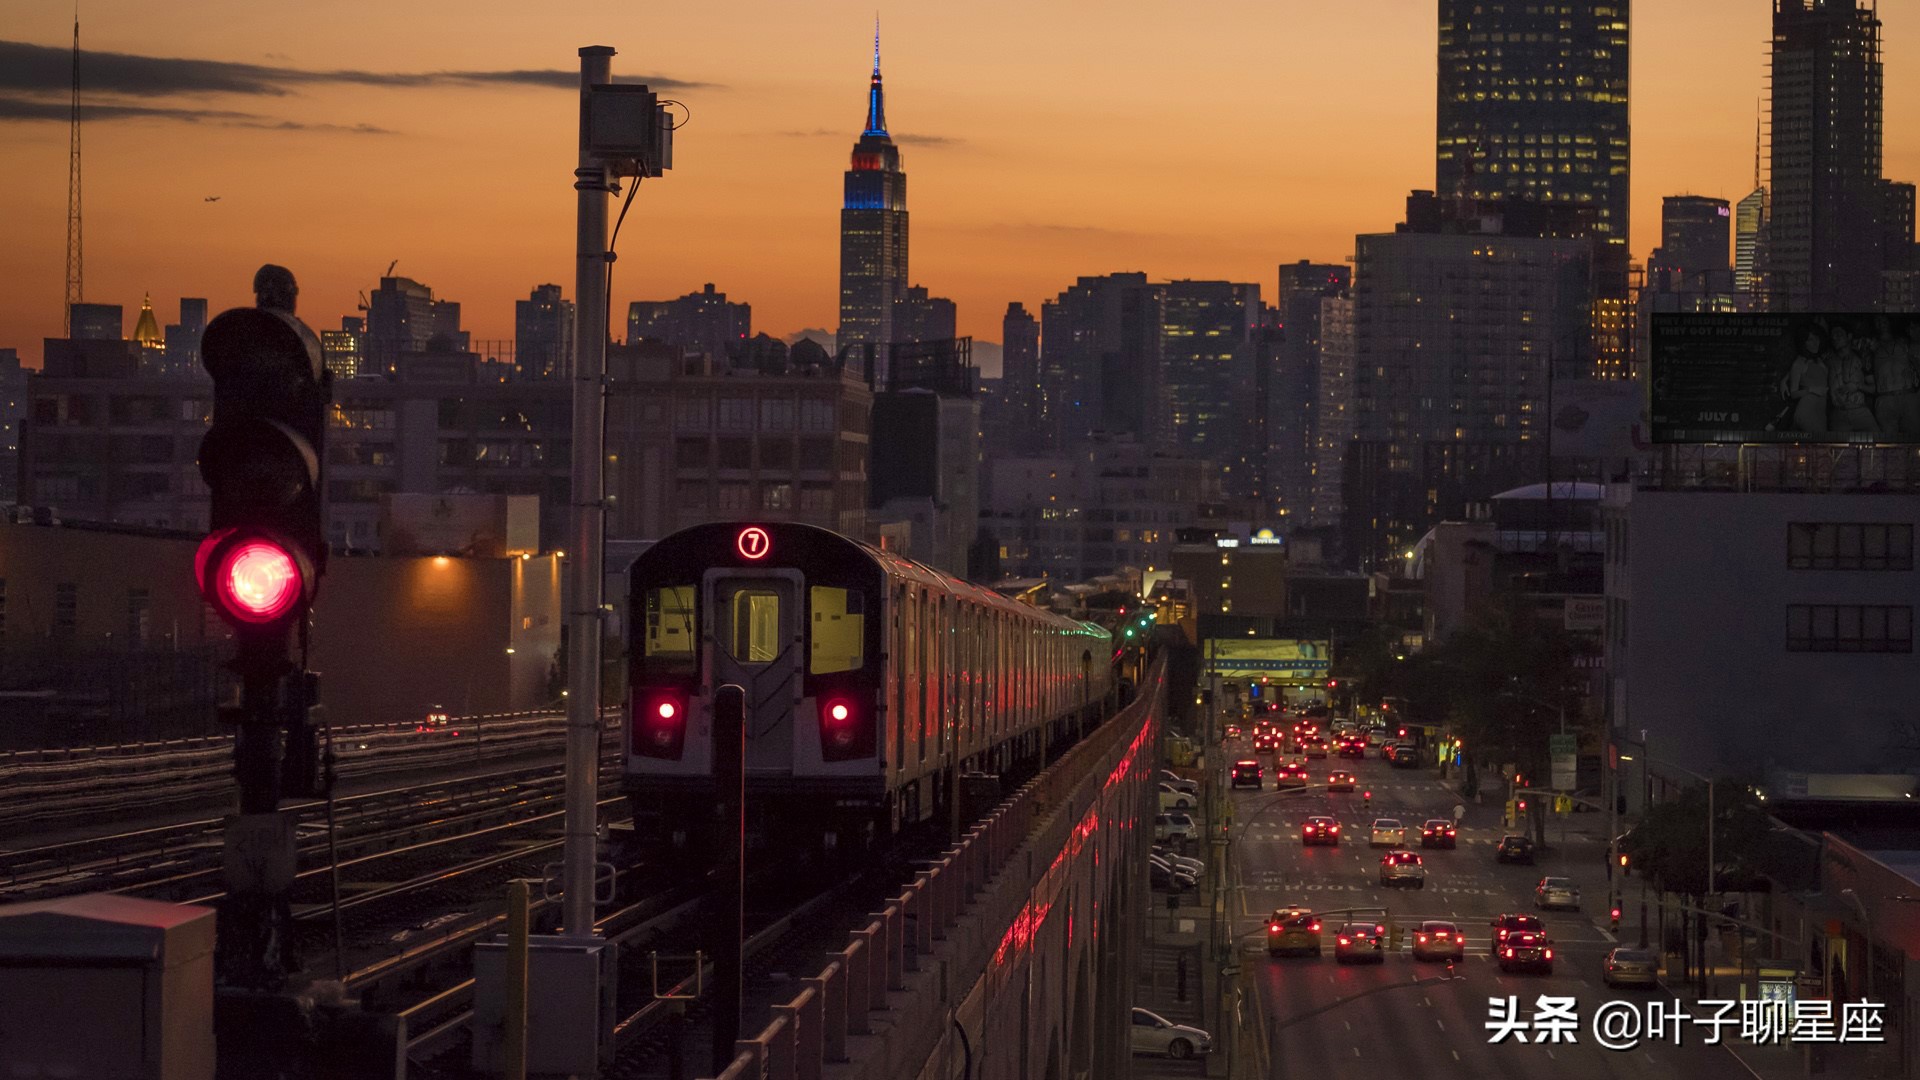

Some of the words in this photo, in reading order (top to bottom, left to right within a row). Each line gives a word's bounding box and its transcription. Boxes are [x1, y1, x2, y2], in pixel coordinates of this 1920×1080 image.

[1655, 317, 1679, 326] THEY
[1757, 317, 1790, 326] GIRLS
[1659, 326, 1687, 336] THEY
[1689, 326, 1713, 336] GOT
[1741, 327, 1783, 336] MESSES
[1697, 411, 1728, 422] JULY
[1730, 412, 1740, 422] 8
